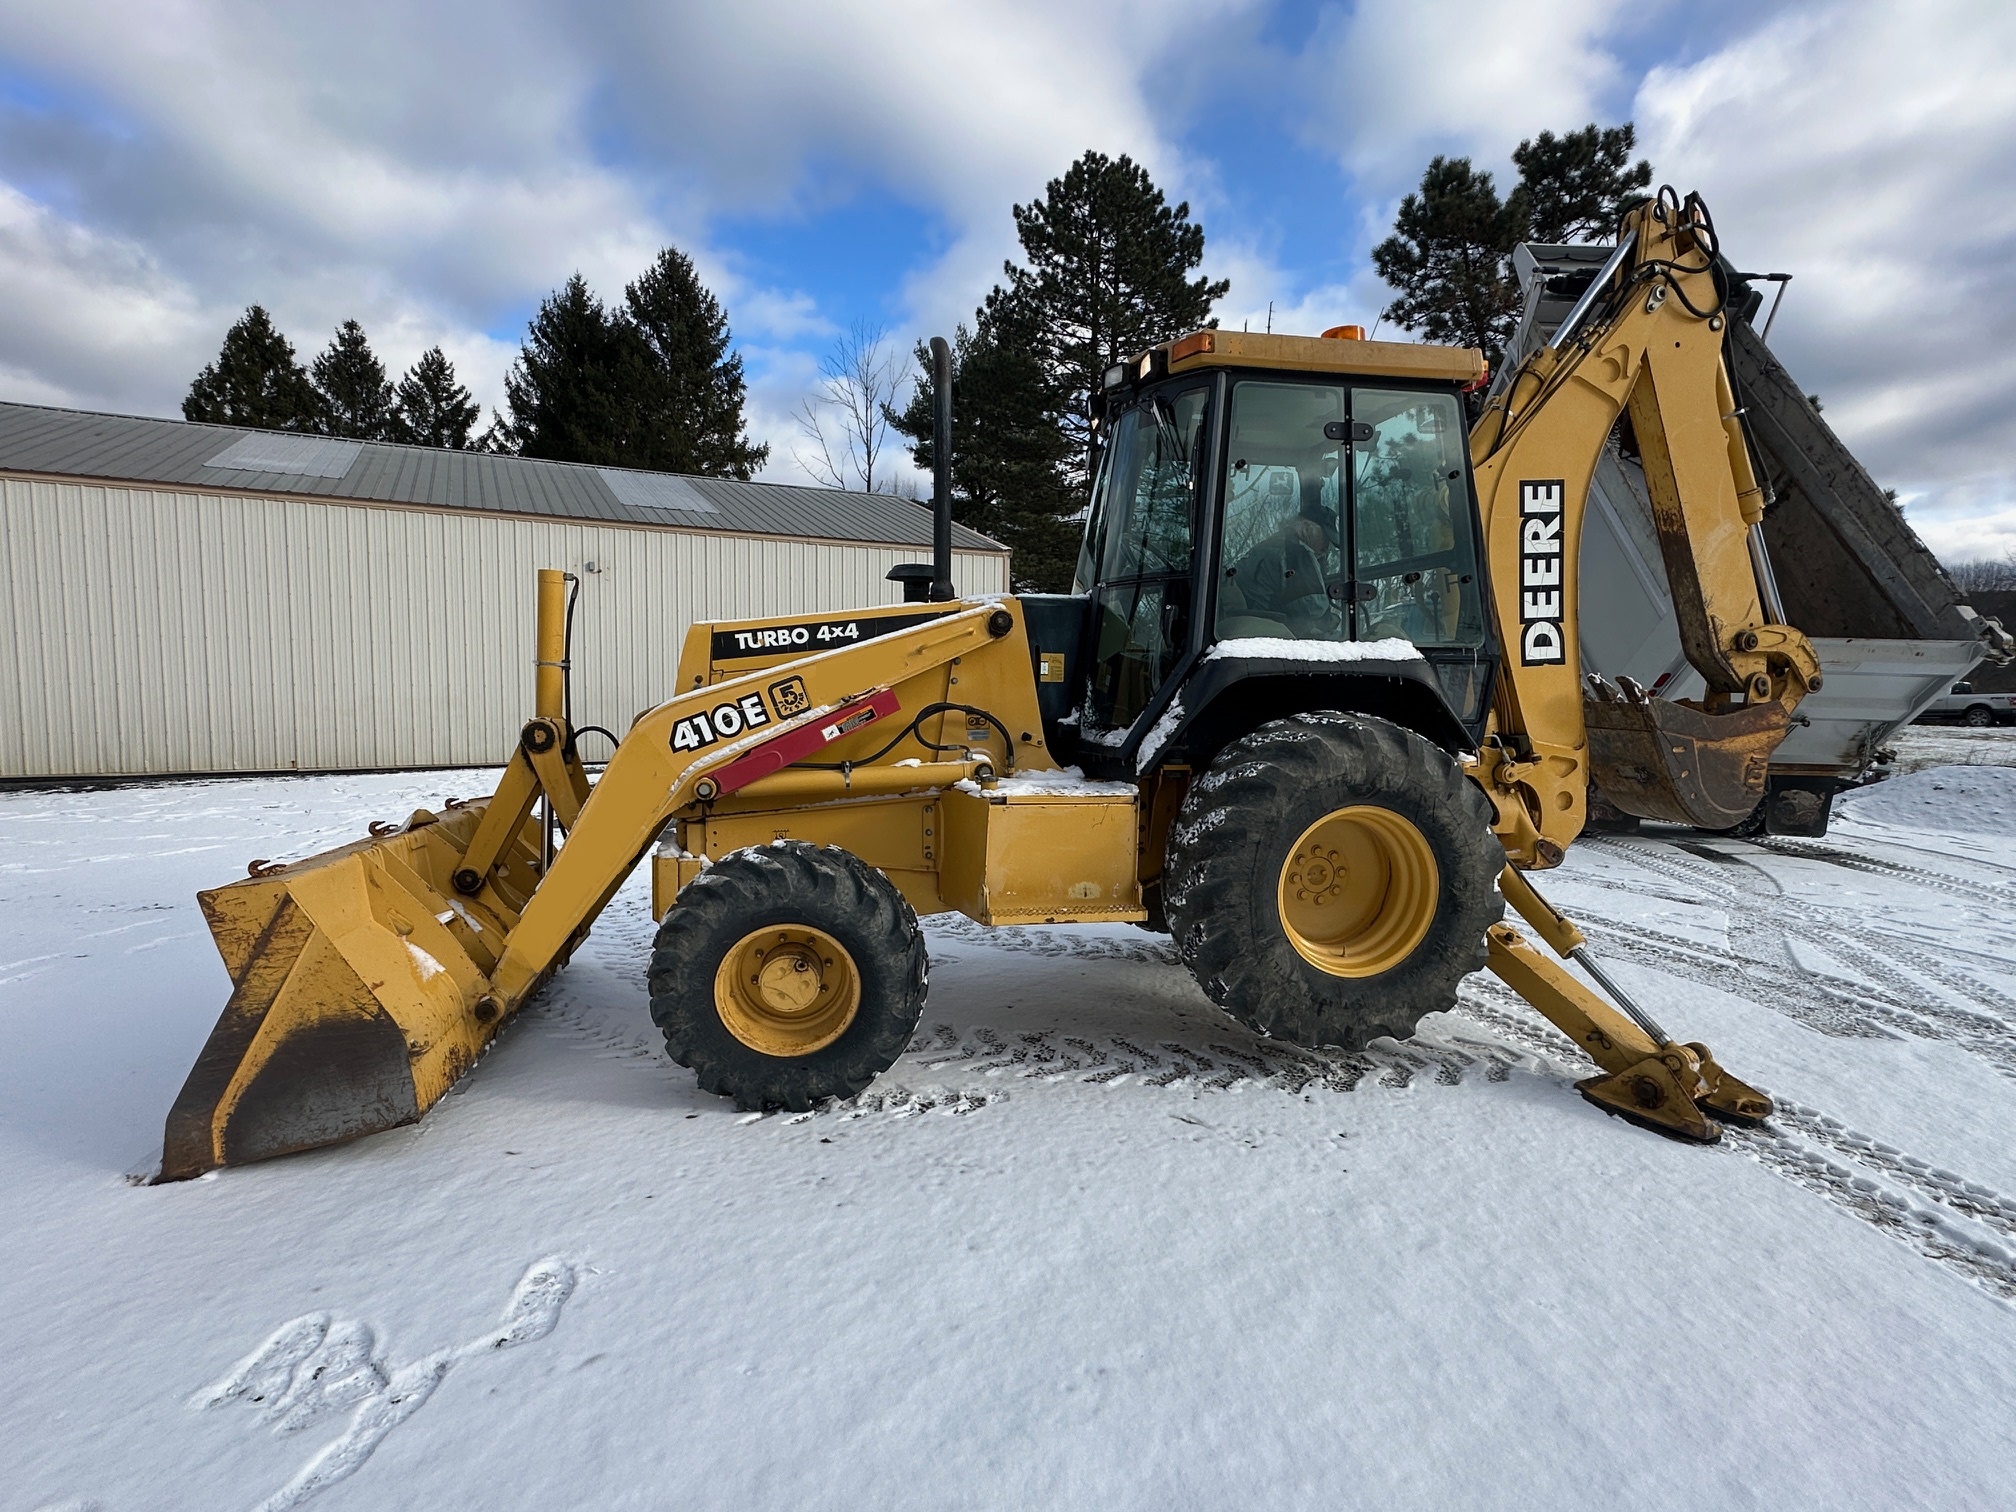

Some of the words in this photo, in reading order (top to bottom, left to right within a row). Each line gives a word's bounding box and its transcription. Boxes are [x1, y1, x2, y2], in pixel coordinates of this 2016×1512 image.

[1523, 484, 1562, 661] DEERE
[734, 627, 810, 650] TURBO
[816, 622, 860, 642] 4x4
[672, 694, 768, 750] 410E
